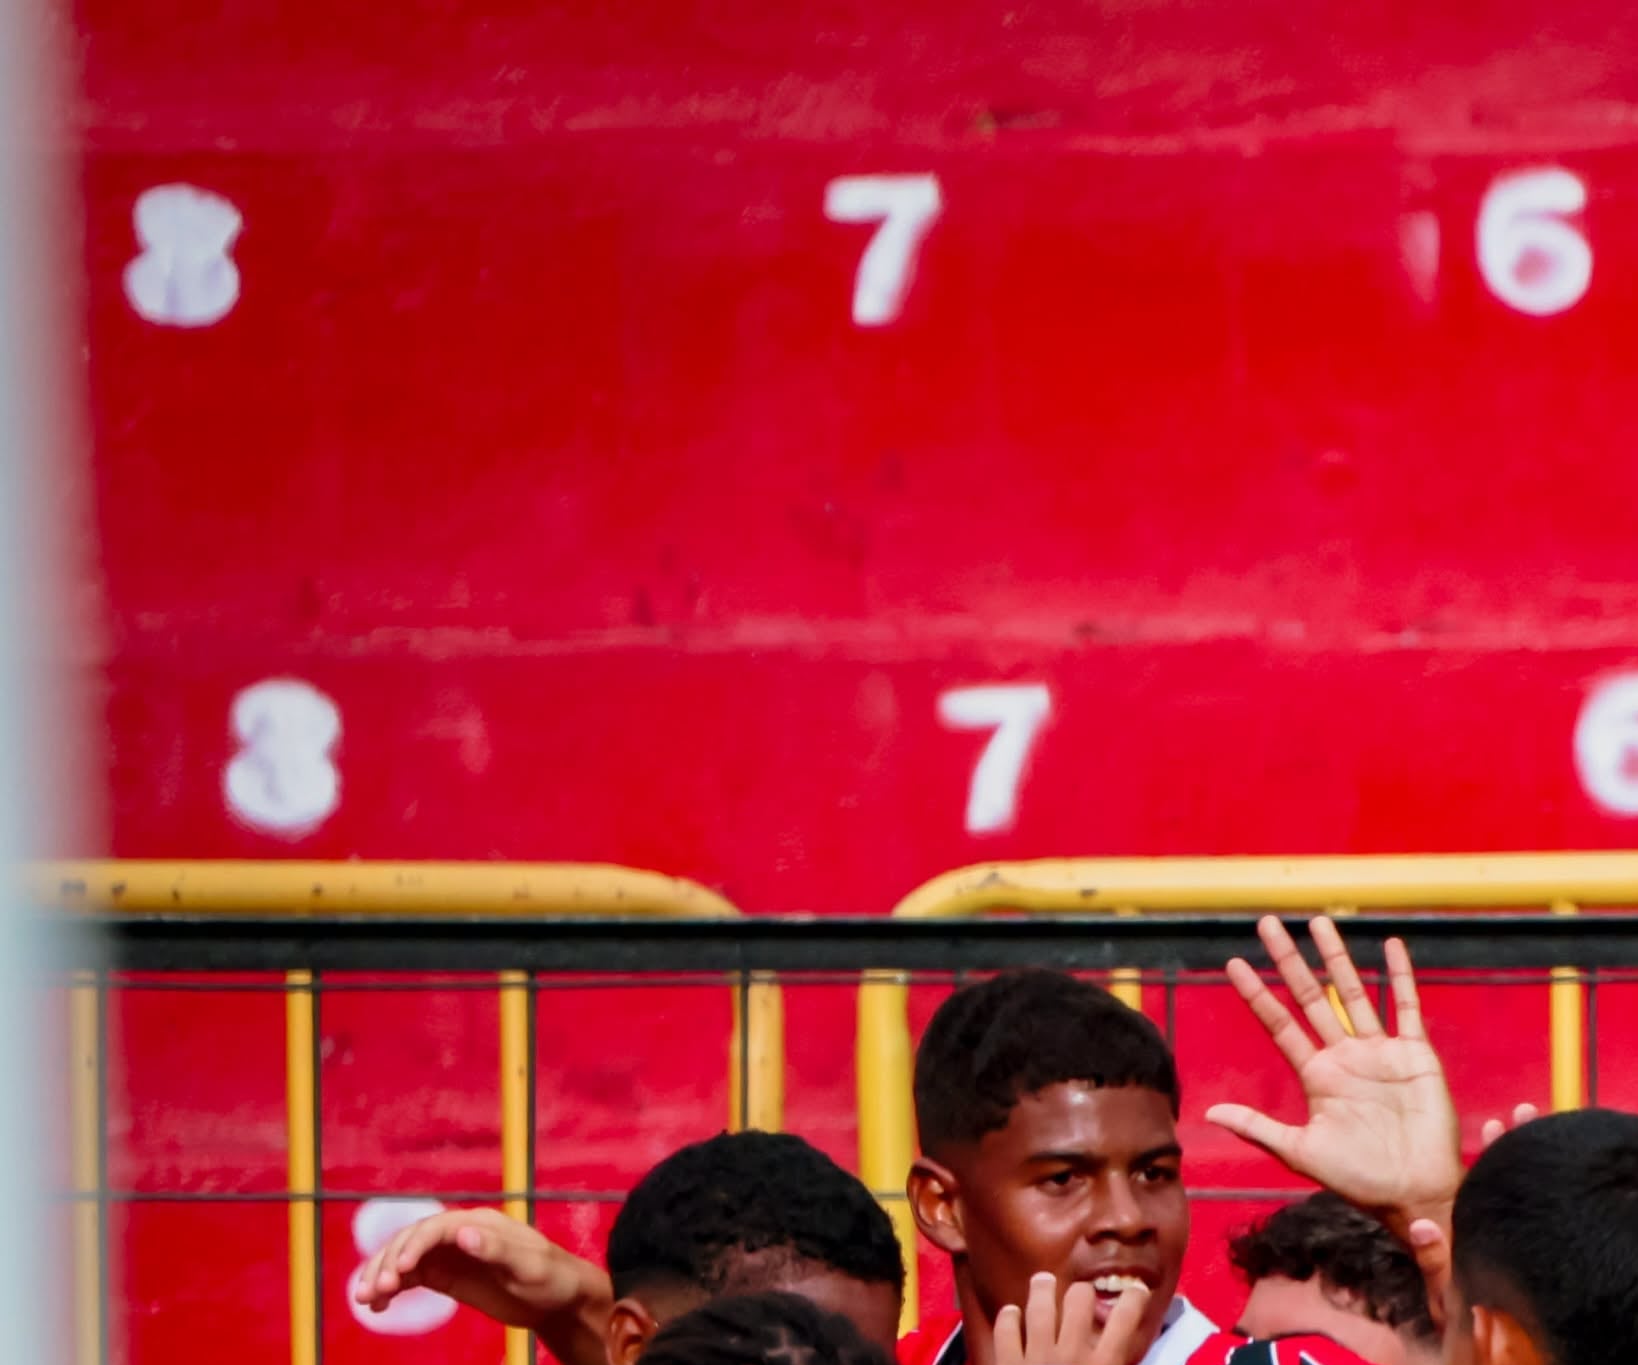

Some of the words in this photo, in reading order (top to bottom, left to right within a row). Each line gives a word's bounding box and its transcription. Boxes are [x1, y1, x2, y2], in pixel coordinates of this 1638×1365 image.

[124, 184, 243, 327] 8
[825, 173, 941, 325] 7
[1476, 167, 1594, 316] 6
[223, 677, 342, 836] 8
[937, 682, 1052, 835] 7
